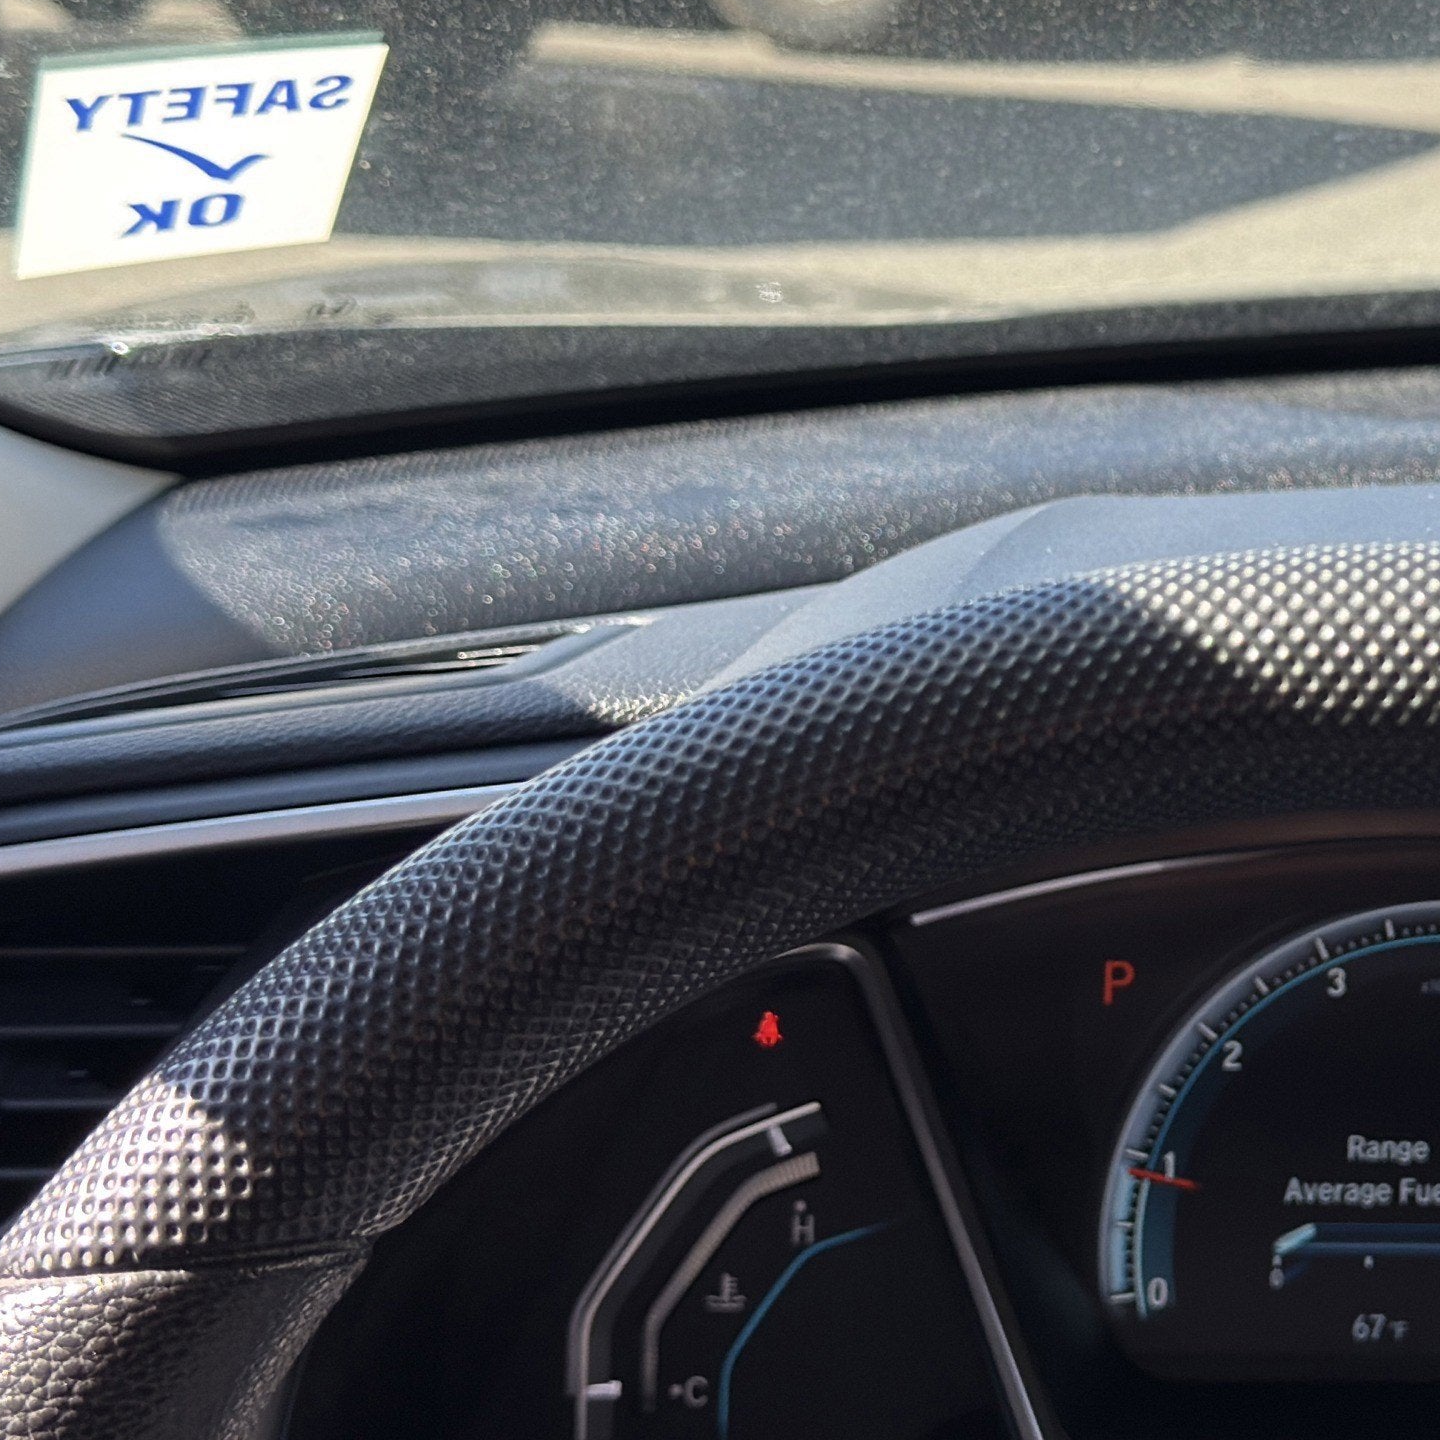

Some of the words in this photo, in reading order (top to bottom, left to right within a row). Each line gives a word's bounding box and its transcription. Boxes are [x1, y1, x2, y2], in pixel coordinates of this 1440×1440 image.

[1103, 960, 1136, 1005] P
[1326, 967, 1347, 997] 3
[1222, 1040, 1243, 1072] 2
[1164, 1151, 1176, 1179] 1
[1347, 1134, 1430, 1165] Range
[1284, 1177, 1392, 1209] Average
[792, 1215, 815, 1244] H
[1147, 1276, 1168, 1309] 0
[684, 1375, 708, 1408] C
